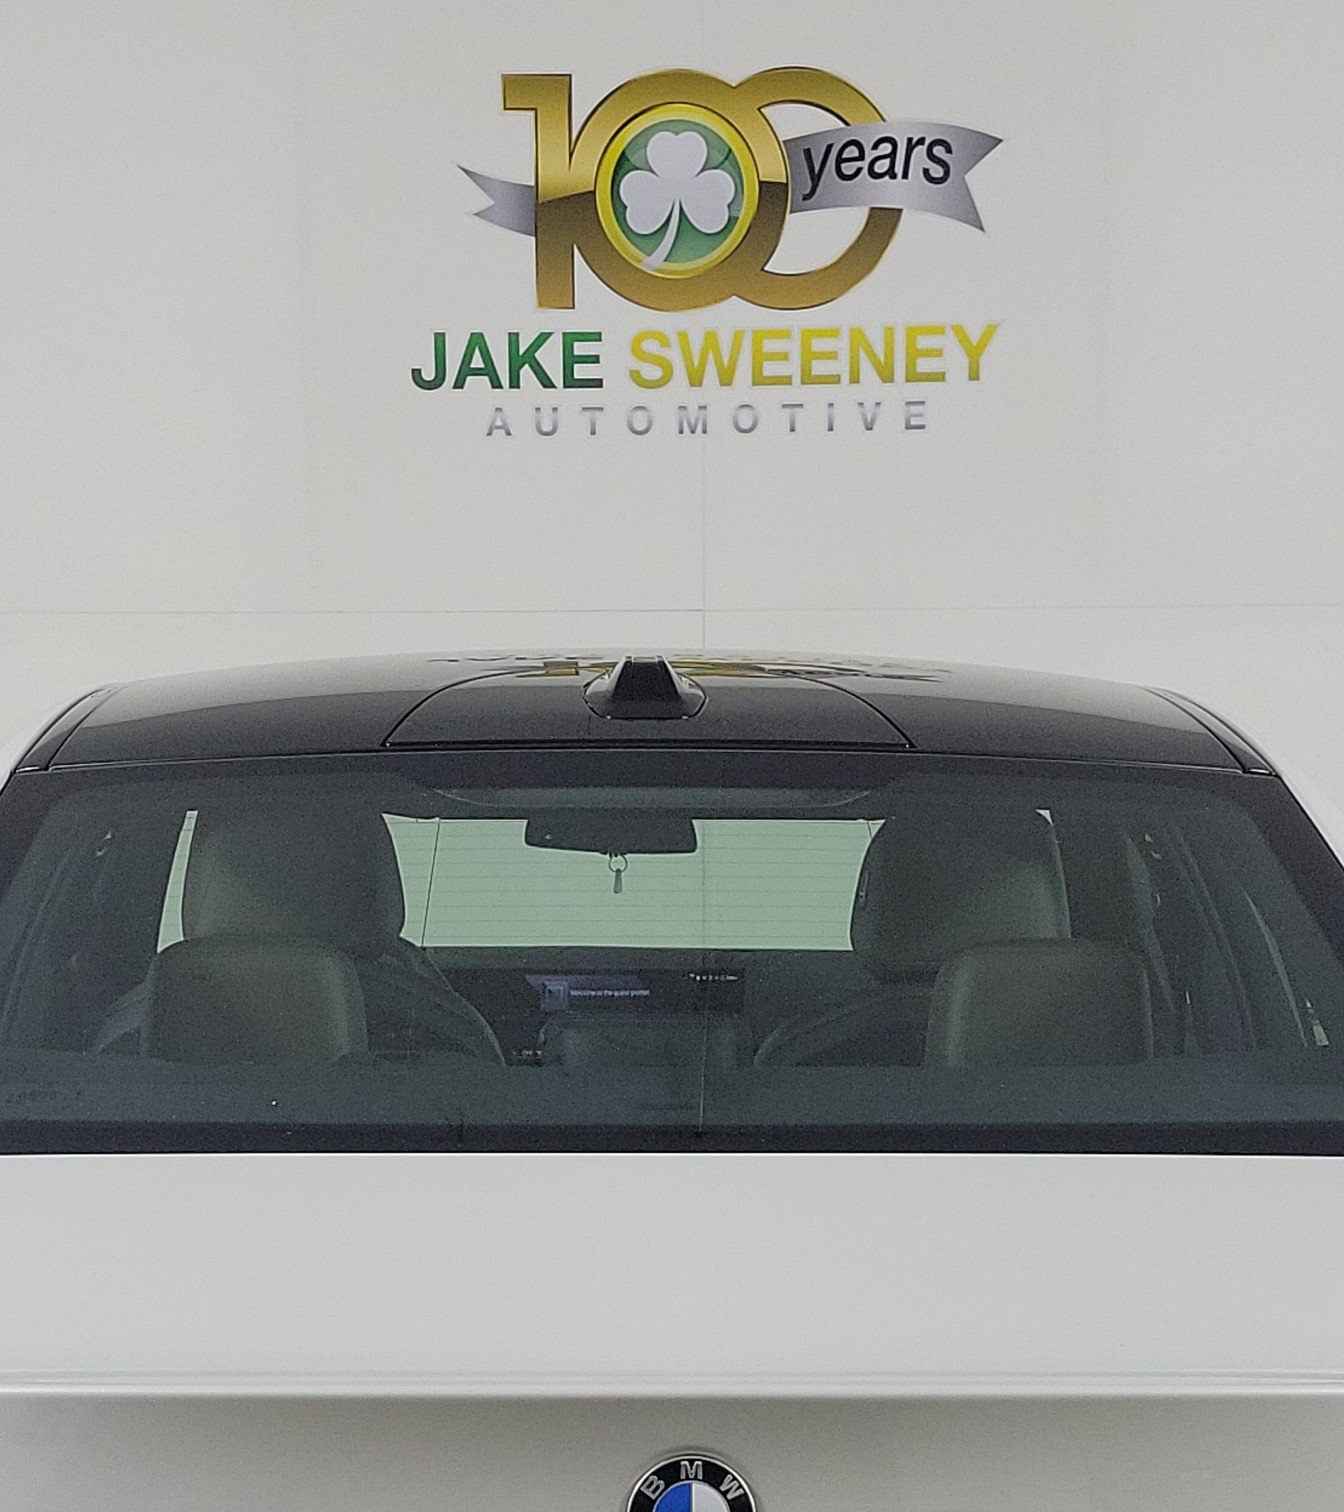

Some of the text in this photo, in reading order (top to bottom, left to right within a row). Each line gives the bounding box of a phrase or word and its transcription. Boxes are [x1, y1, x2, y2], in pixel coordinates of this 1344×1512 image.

[501, 66, 953, 311] 100 years
[411, 323, 1000, 391] JAKE SWEENEY
[485, 400, 928, 436] AUTOMOTIVE
[640, 1460, 745, 1500] BMW
